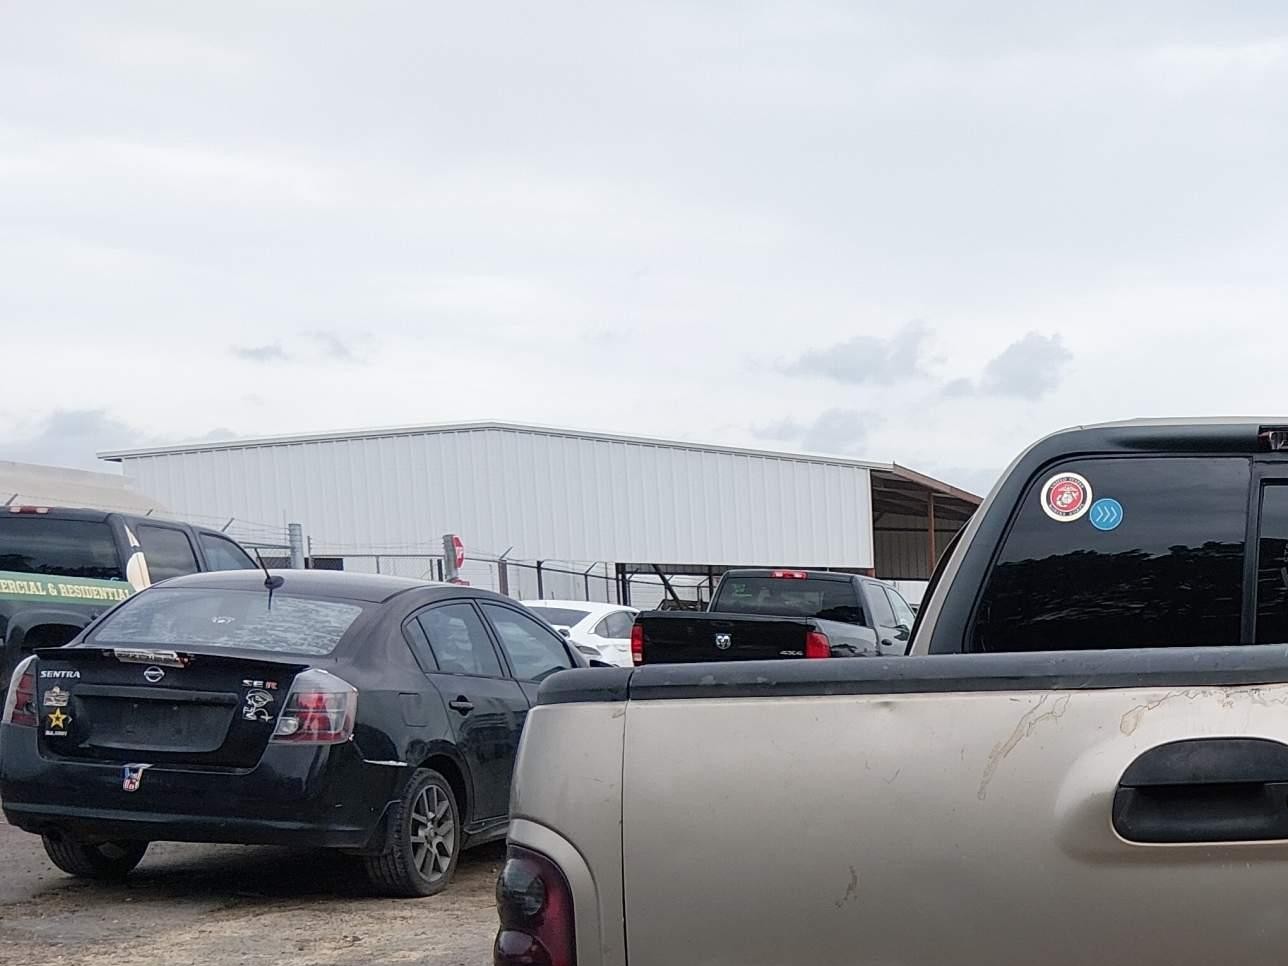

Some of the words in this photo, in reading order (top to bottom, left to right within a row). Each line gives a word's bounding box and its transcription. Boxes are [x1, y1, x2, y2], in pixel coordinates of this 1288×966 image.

[0, 579, 47, 596] ERCIAL
[48, 582, 58, 596] &
[40, 670, 81, 679] SENTRA
